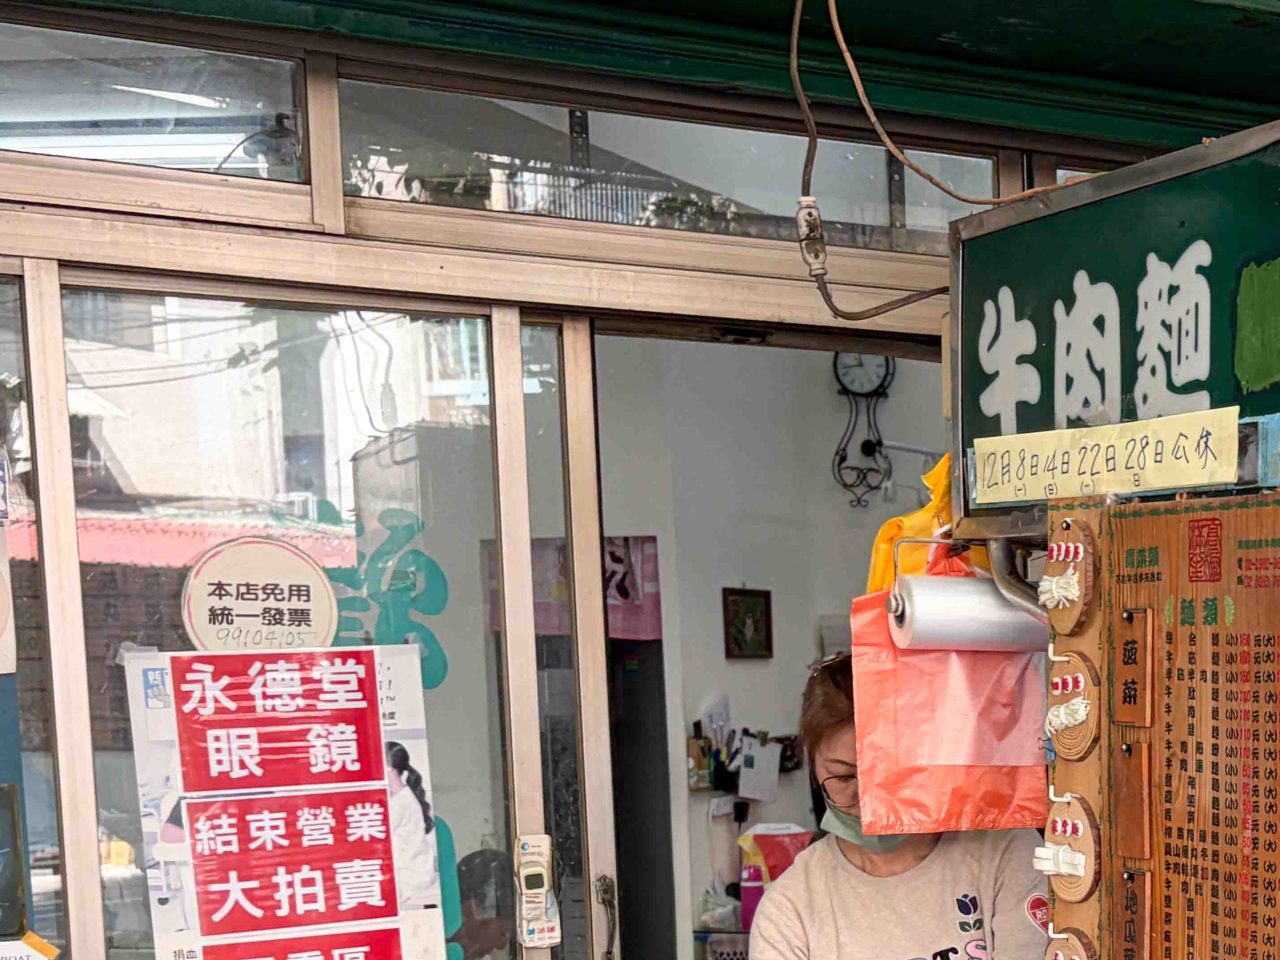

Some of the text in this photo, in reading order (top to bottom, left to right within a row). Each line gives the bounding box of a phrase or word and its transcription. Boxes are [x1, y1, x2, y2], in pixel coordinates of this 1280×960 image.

[978, 238, 1213, 430] 牛肉麵
[207, 581, 311, 603] 本店免用
[208, 606, 312, 627] 統一發票
[180, 658, 368, 717] 永德堂
[206, 725, 362, 780] 眼鏡
[195, 803, 387, 857] 結束營業
[209, 857, 387, 922] 大拍賣
